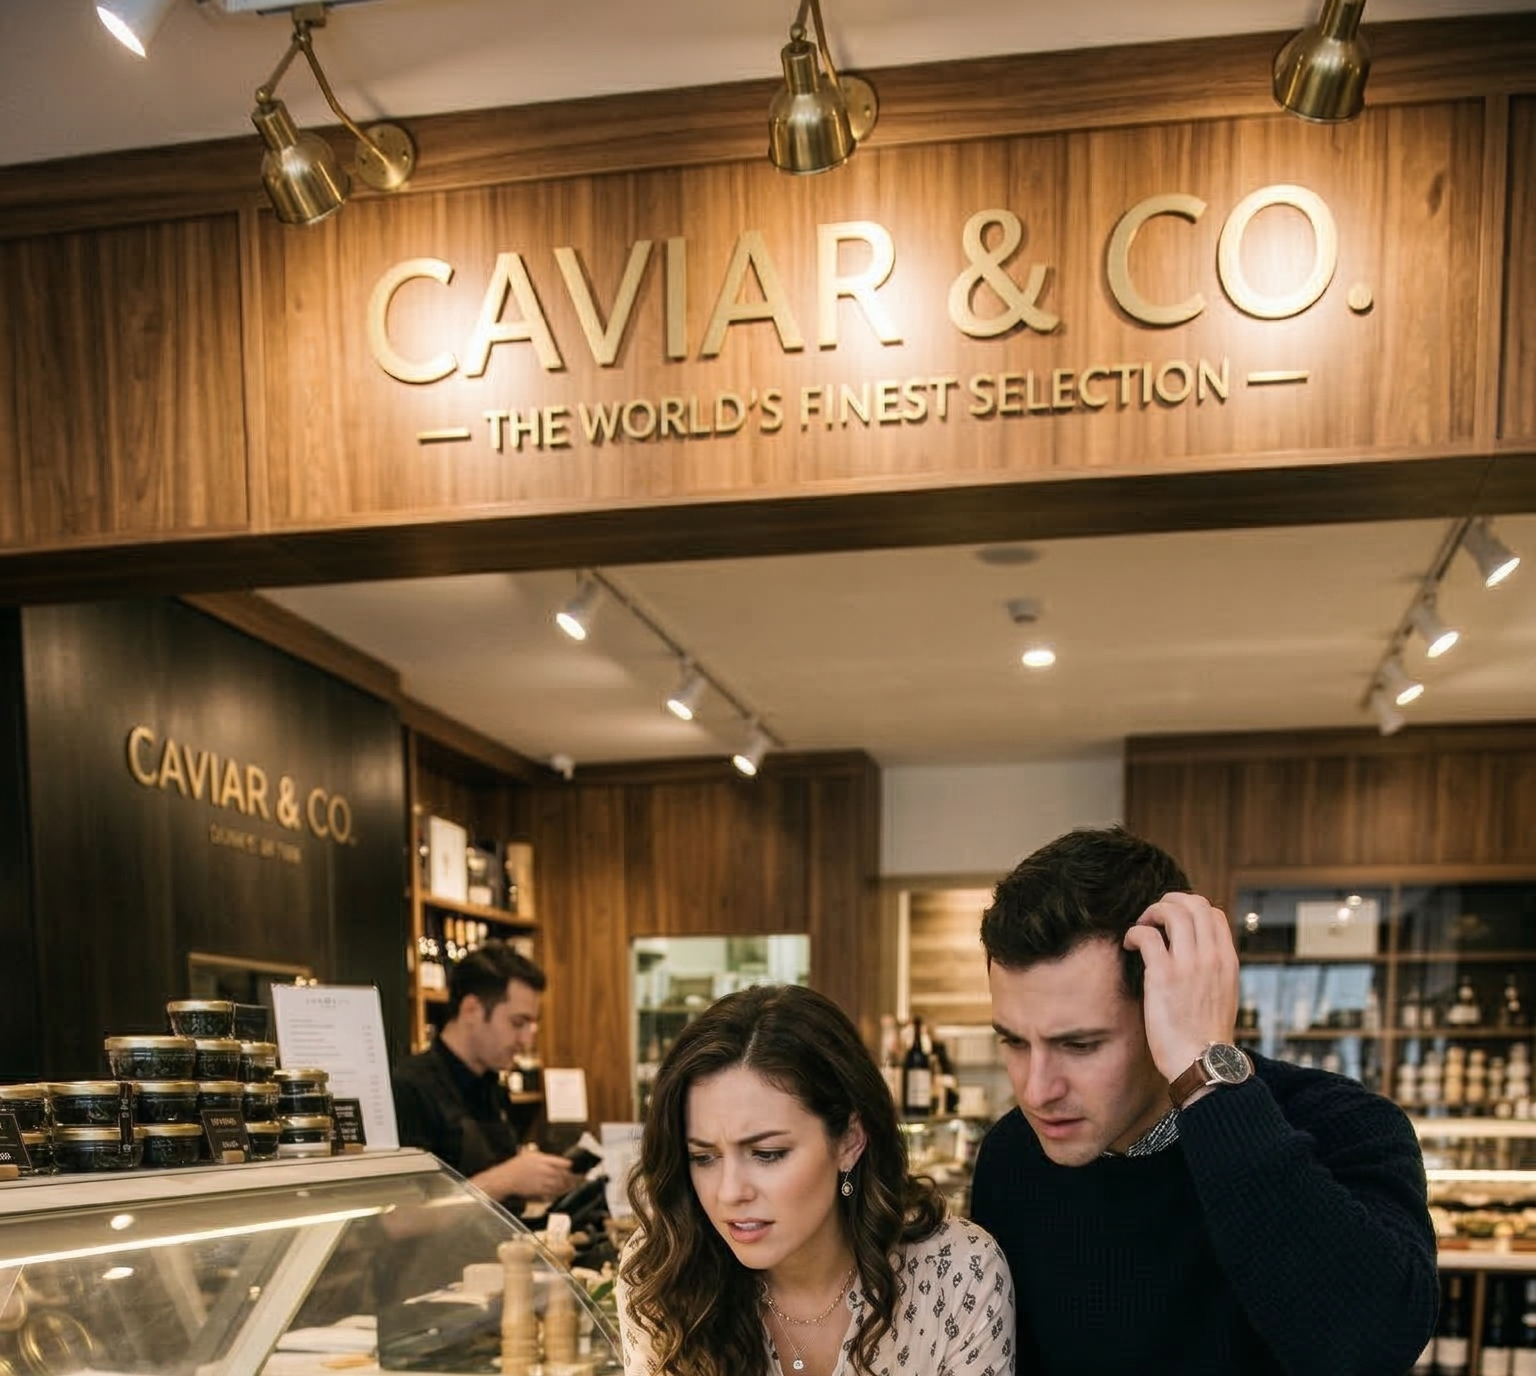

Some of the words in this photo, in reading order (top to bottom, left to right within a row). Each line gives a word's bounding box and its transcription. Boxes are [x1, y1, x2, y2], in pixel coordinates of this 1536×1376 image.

[367, 220, 903, 385] CAVIAR
[947, 207, 1060, 338] &
[1105, 183, 1374, 327] CO.
[485, 404, 570, 451] THE
[577, 387, 782, 442] WORLD'S
[799, 379, 954, 428] FINEST
[969, 359, 1230, 418] SELECTION
[128, 726, 270, 820] CAVIAR
[276, 776, 301, 830] &
